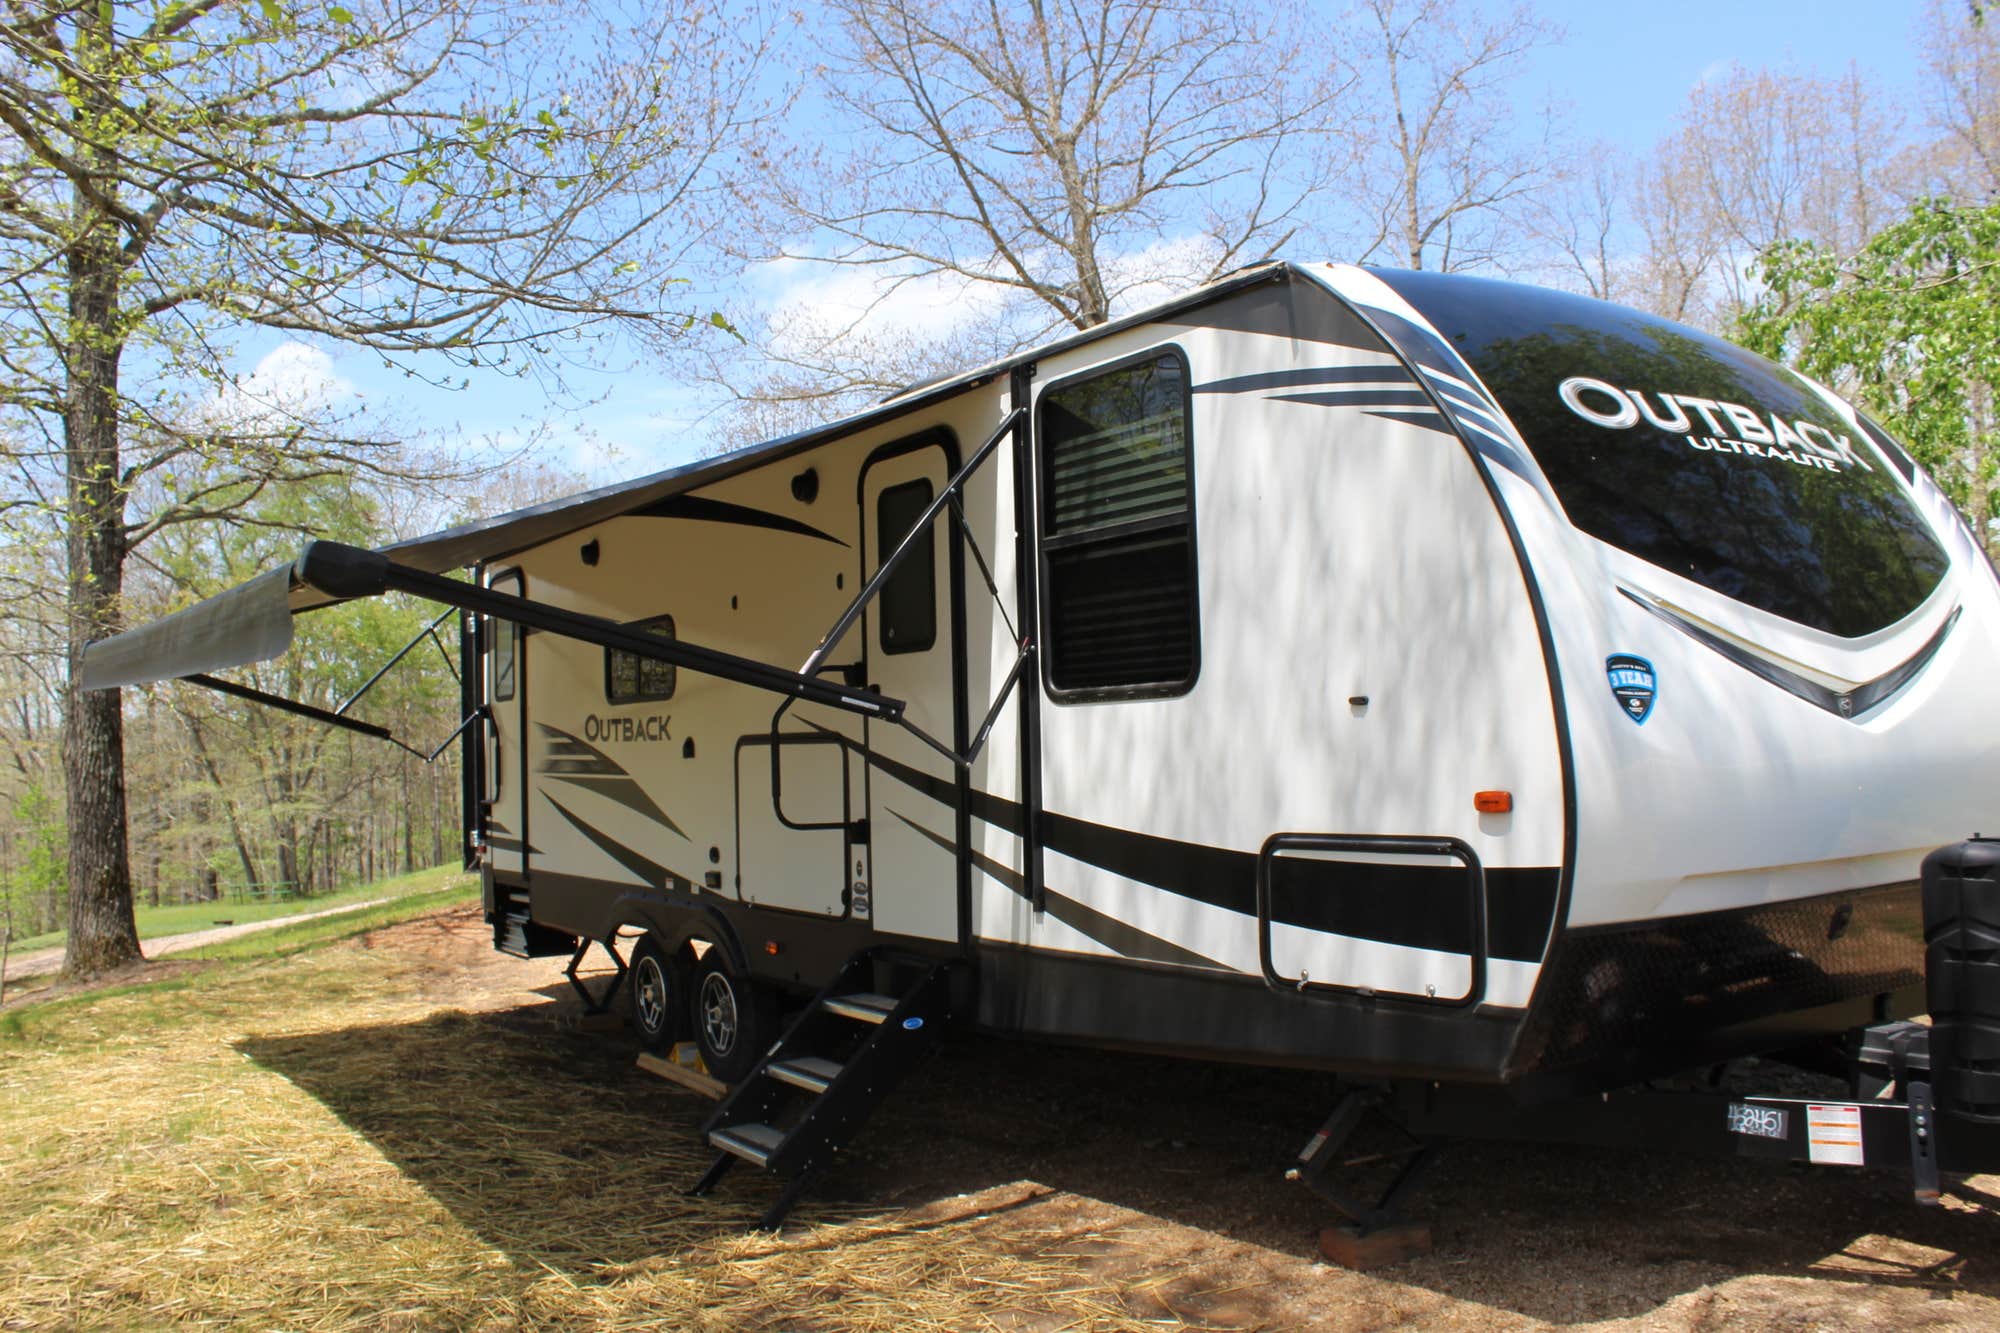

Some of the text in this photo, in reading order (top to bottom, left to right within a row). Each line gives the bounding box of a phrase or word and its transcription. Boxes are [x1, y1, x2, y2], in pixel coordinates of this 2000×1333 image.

[1559, 377, 1873, 472] OUTBACK
[1687, 436, 1841, 472] ULTRA-LITE
[1619, 671, 1653, 688] YEAR
[585, 714, 671, 742] OUTBACK
